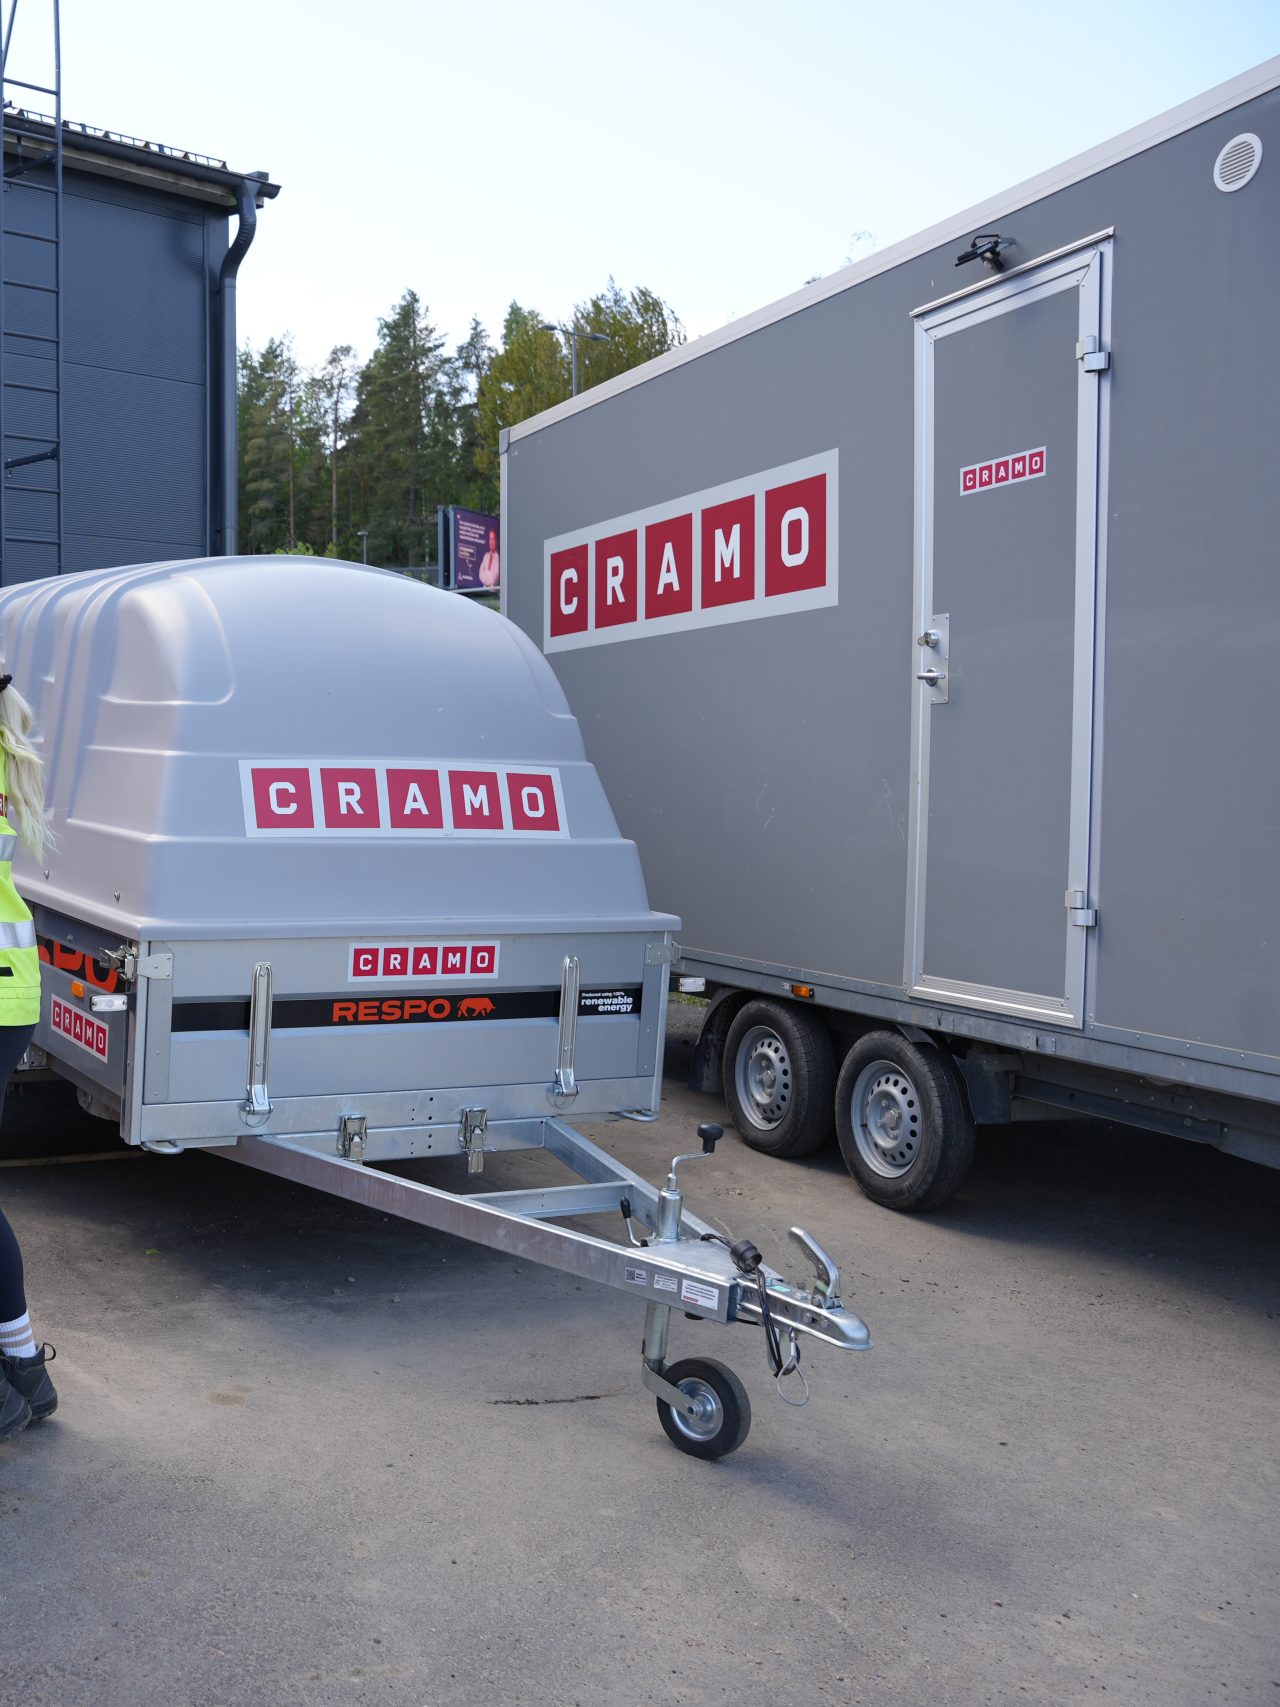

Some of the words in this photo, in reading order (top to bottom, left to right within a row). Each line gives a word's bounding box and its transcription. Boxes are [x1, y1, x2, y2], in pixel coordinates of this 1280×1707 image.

[966, 456, 1040, 486] CRAMO
[560, 506, 810, 615] CRAMO
[268, 781, 546, 818] CRAMO
[359, 952, 489, 971] CRAMO
[332, 998, 451, 1023] RESPO
[581, 996, 633, 1005] renewable
[598, 1004, 633, 1012] energy
[54, 1007, 104, 1050] CRAMO
